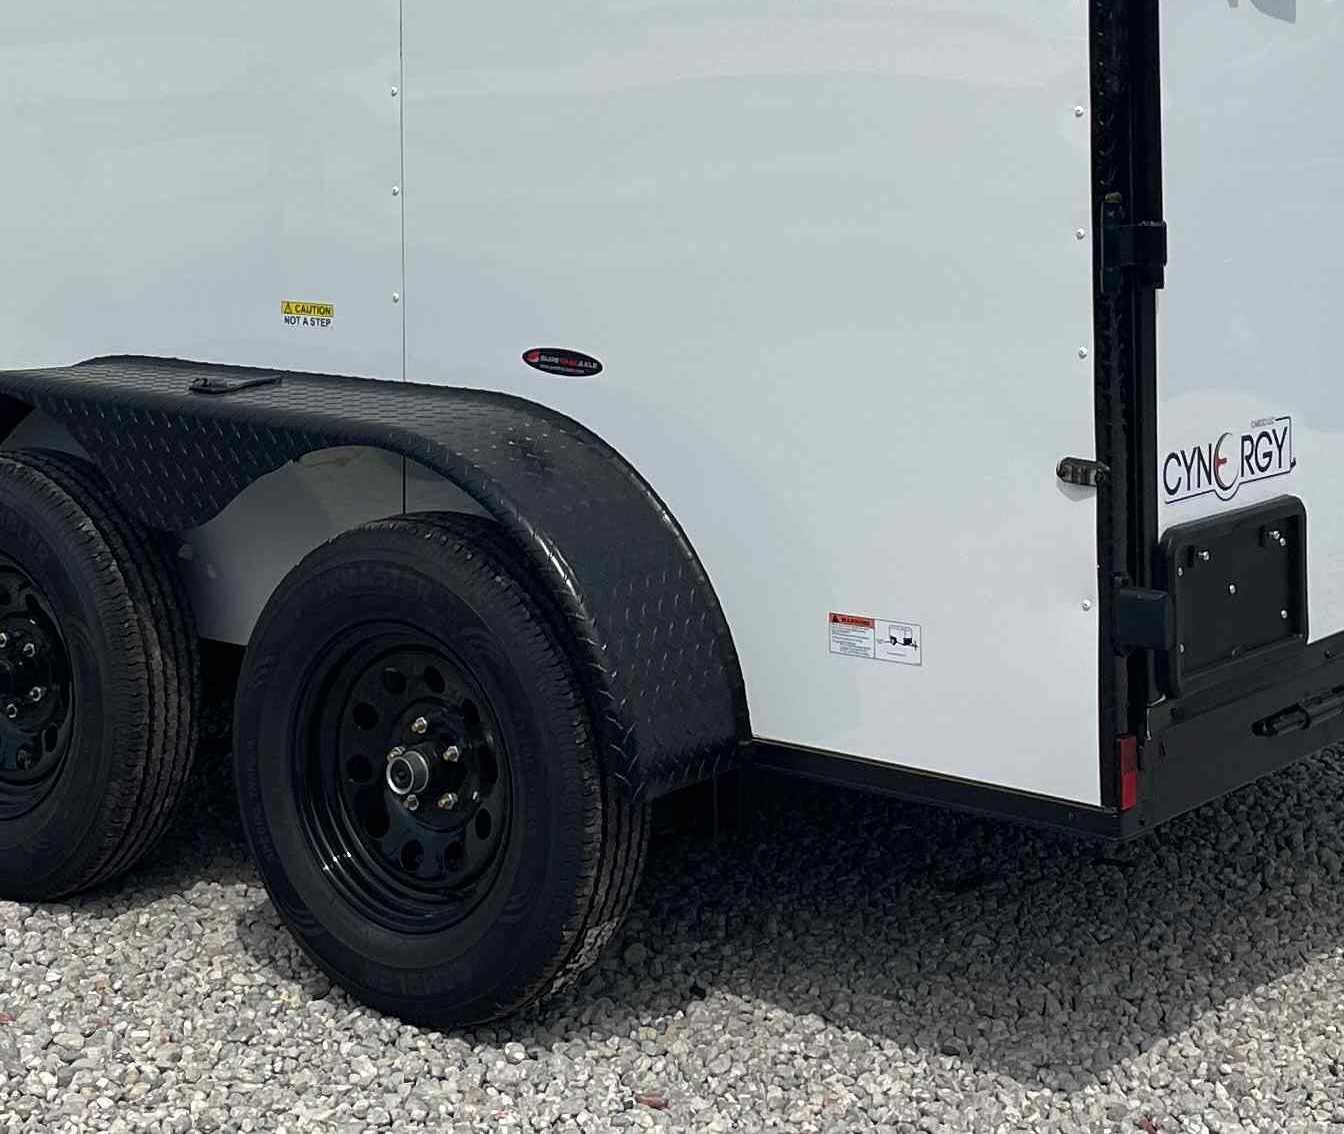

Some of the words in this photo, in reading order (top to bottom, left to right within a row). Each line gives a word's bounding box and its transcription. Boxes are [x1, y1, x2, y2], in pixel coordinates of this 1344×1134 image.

[294, 304, 331, 316] CAUTION
[283, 315, 301, 325] NOT
[310, 317, 332, 328] STEP
[1163, 426, 1288, 496] CYNERGY
